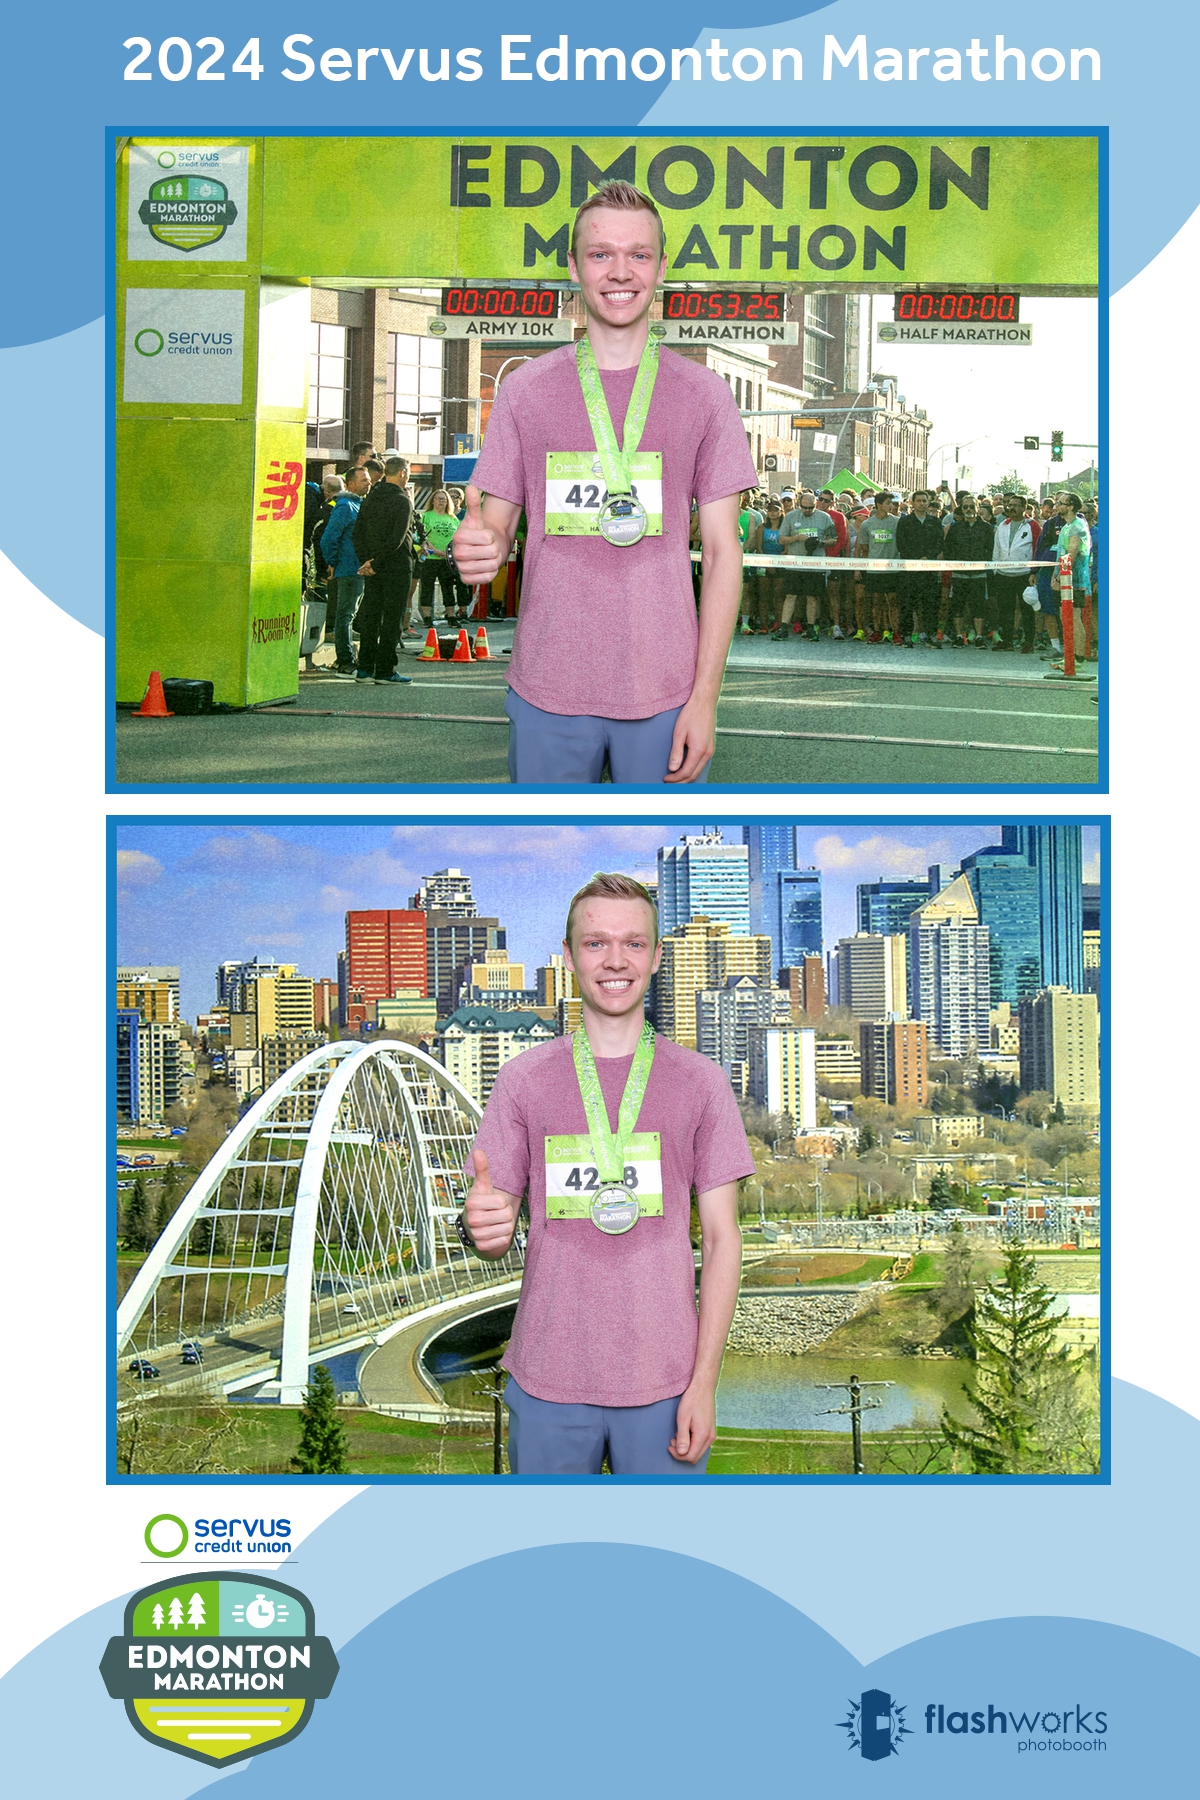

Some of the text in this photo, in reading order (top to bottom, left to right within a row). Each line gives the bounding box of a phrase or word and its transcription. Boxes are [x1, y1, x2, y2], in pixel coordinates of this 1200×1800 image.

[178, 152, 219, 161] servus
[450, 145, 990, 211] EDMONTON
[149, 203, 227, 214] EDMONTON
[160, 214, 215, 222] MARATHON
[465, 321, 554, 336] ARMY 10K
[679, 325, 785, 340] MARATHON
[900, 328, 1030, 340] HALF MARATHON
[168, 332, 233, 345] servus
[168, 345, 233, 355] credit union
[257, 613, 290, 635] Running
[565, 1166, 639, 1190] 428
